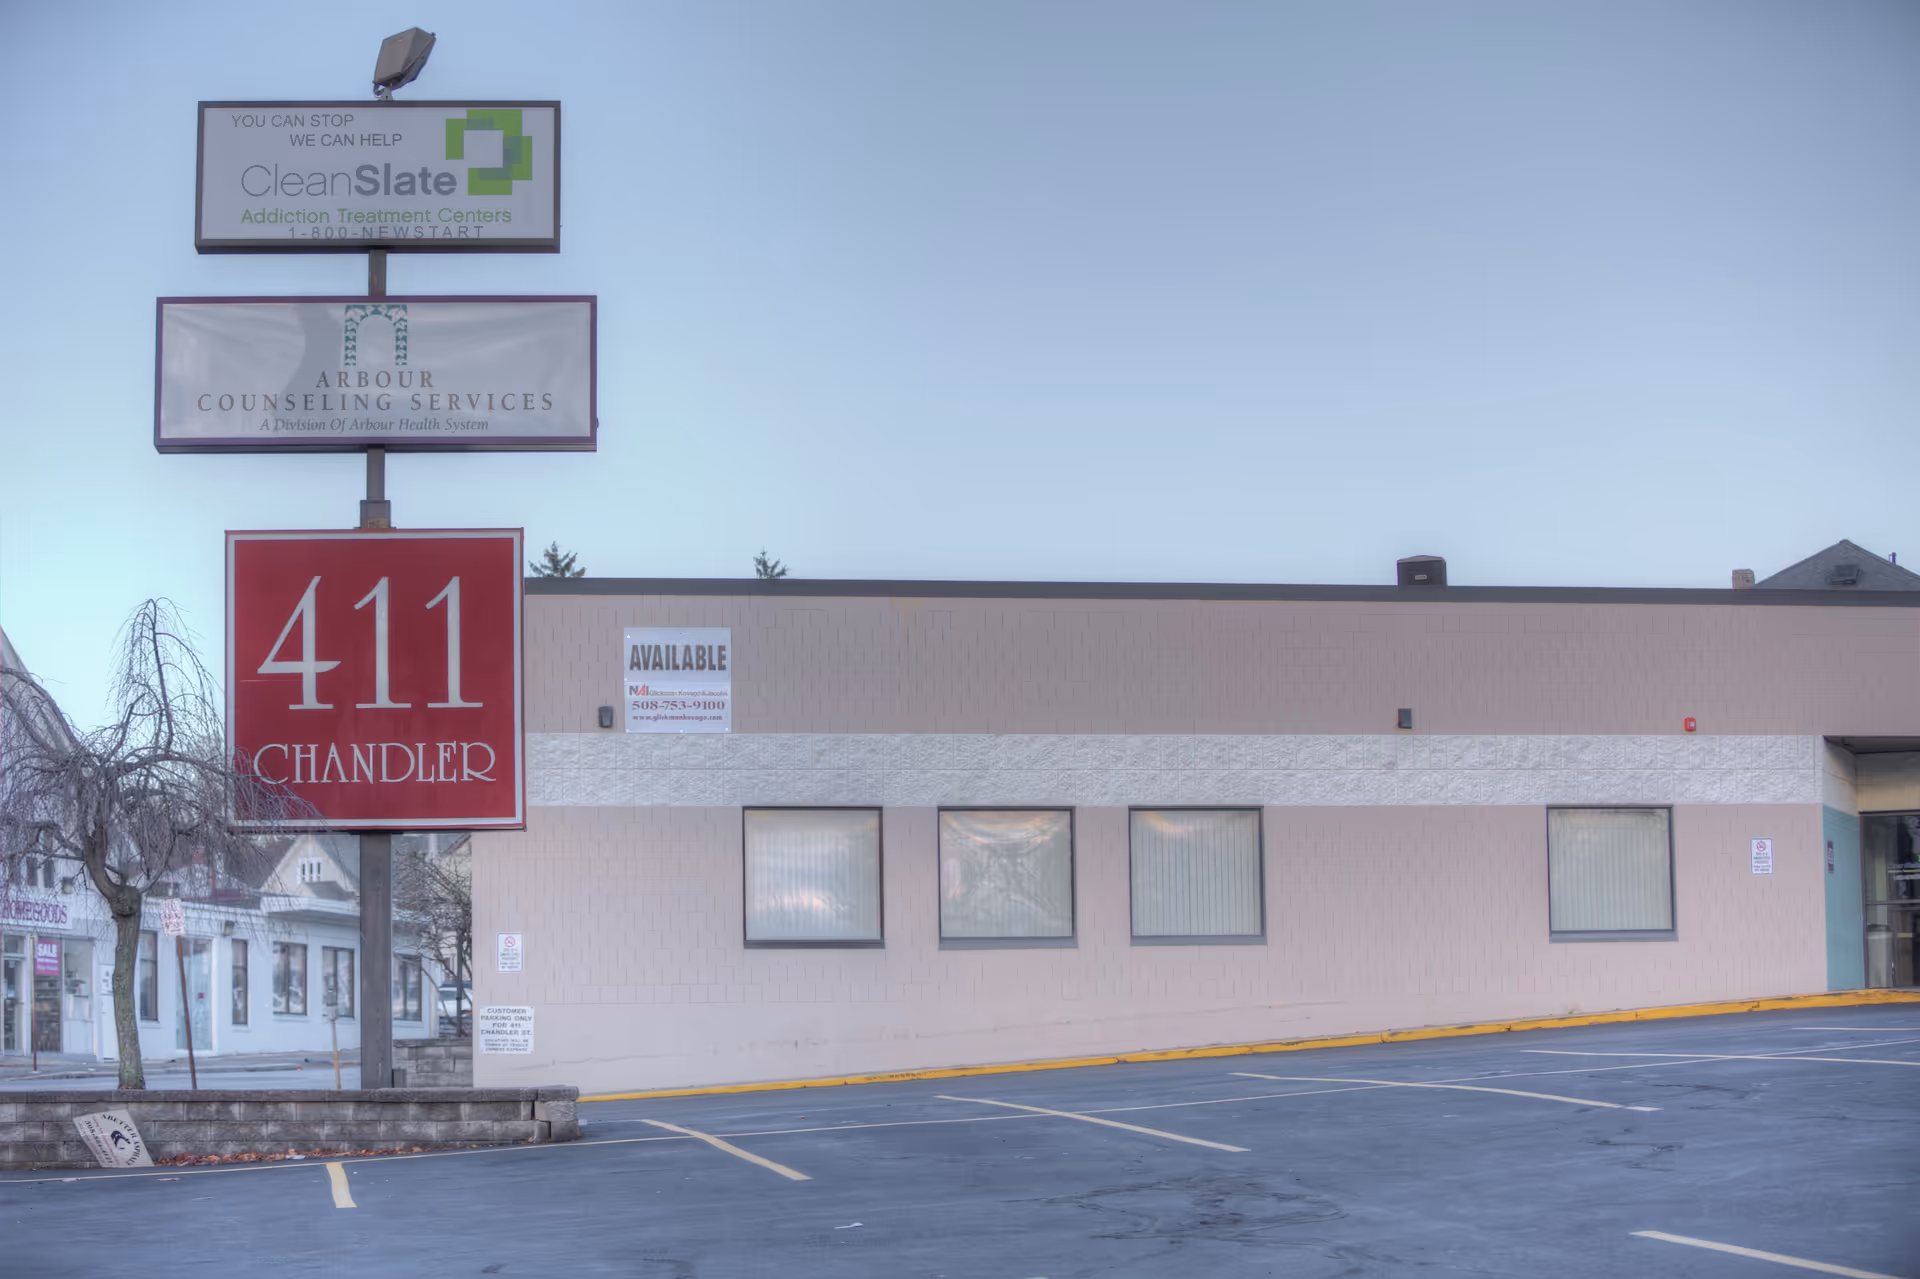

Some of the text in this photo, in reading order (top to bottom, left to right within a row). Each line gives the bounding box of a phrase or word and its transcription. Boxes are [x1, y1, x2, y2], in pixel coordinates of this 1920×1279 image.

[231, 114, 354, 127] YOU CAN STOP
[290, 133, 402, 146] WE CAN HELP
[241, 163, 457, 197] CleanSlate
[241, 208, 512, 224] Addiction Treatment Centers
[288, 226, 484, 240] 1-800-NEWSTART
[316, 371, 433, 388] ARBOUR
[197, 393, 553, 411] COUNSELING SERVICES
[259, 418, 489, 433] A Division Of Arbour Health System
[257, 576, 483, 709] 411
[629, 644, 727, 671] AVAILABLE
[632, 700, 725, 710] 508-753-9100
[253, 741, 496, 784] CHANDLER
